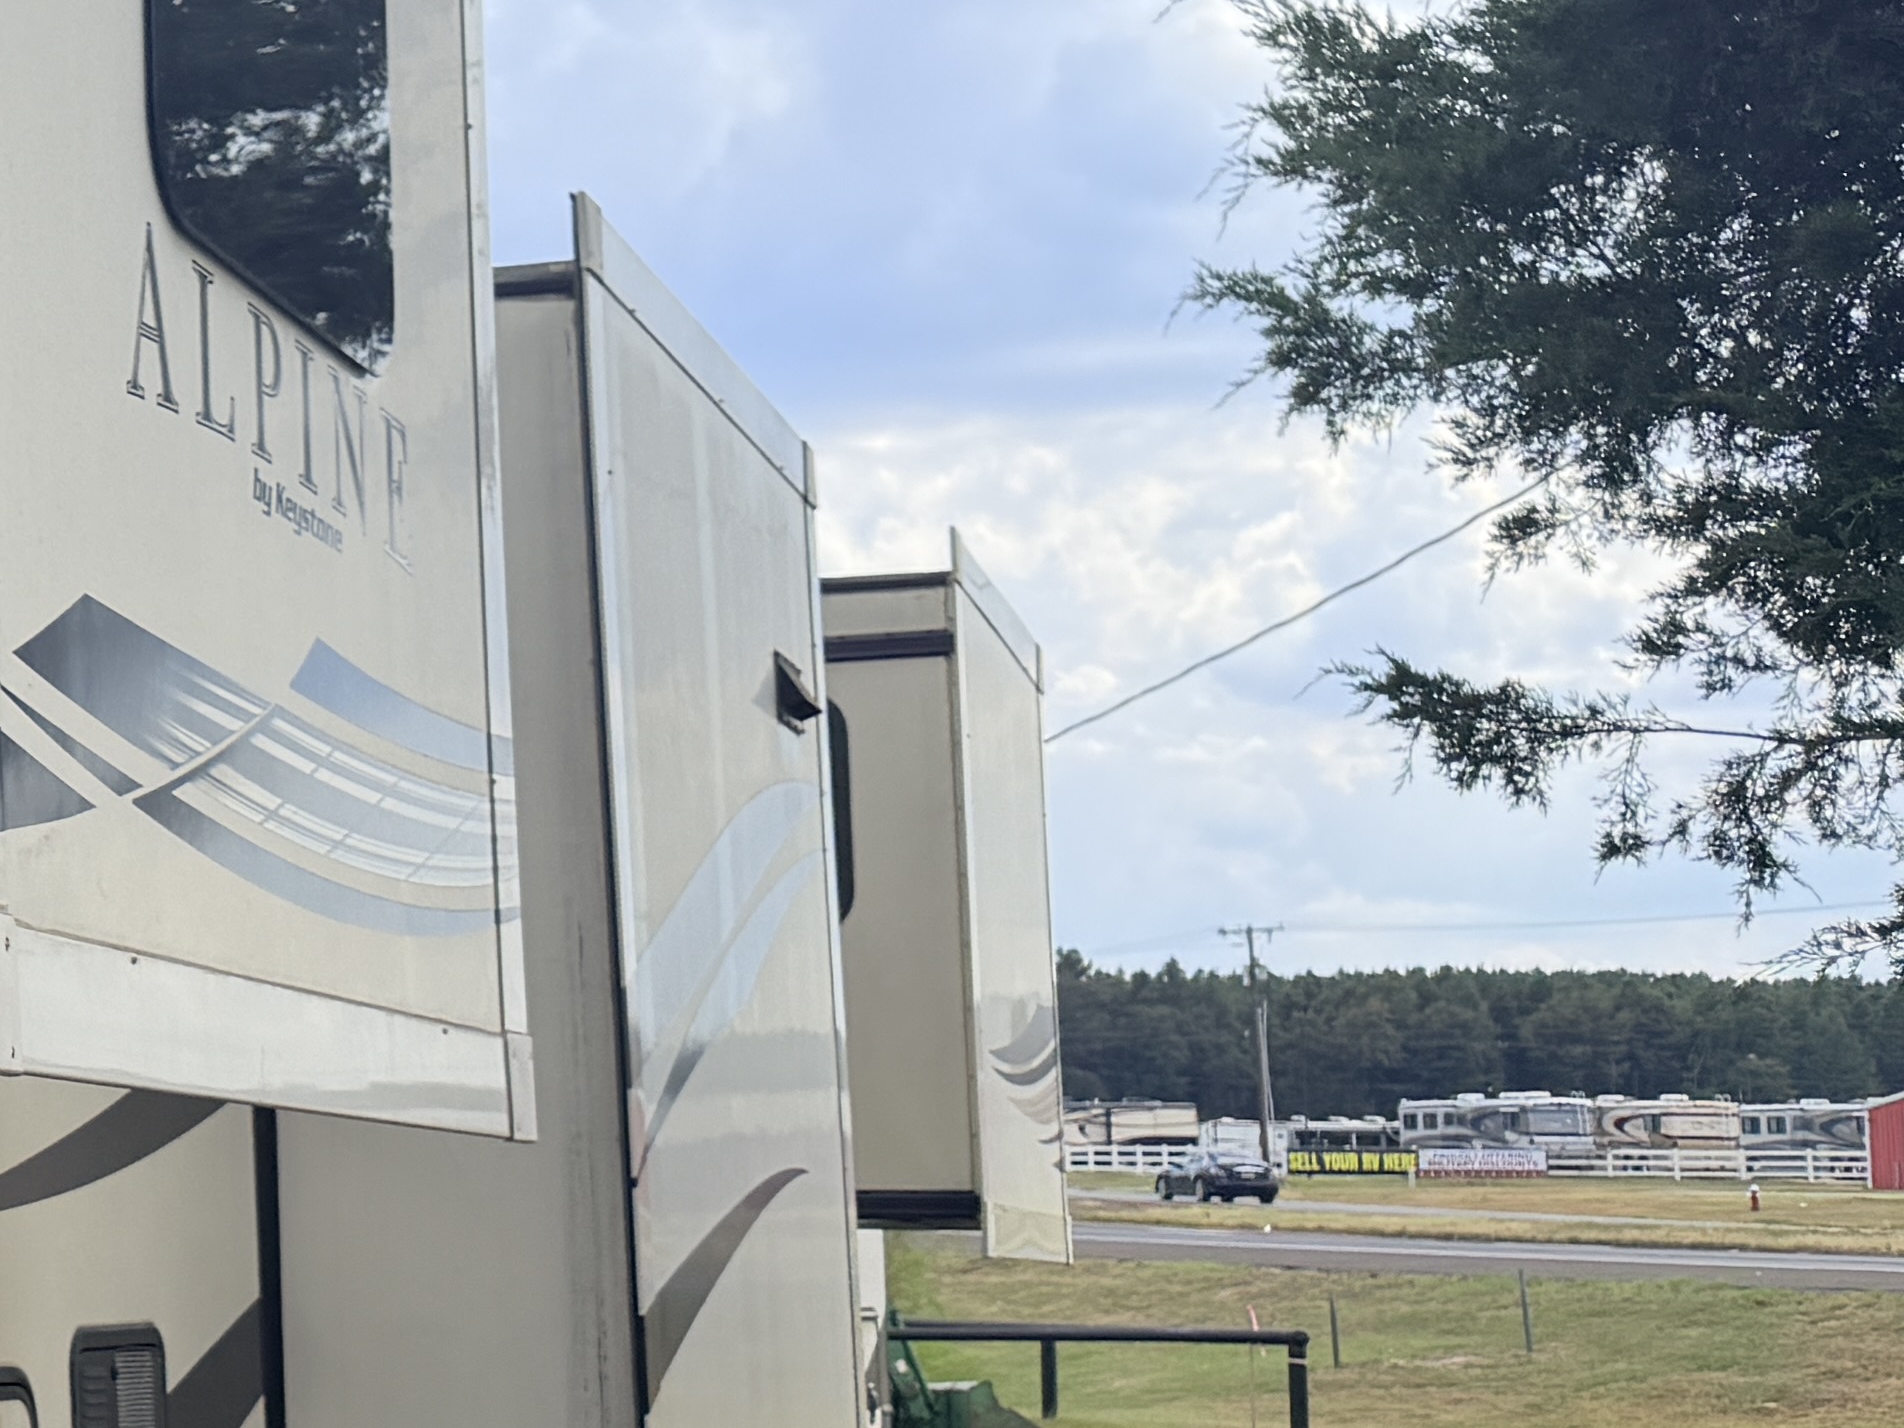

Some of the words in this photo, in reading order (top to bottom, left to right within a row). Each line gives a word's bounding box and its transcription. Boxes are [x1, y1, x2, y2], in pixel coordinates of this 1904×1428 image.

[126, 221, 413, 575] ALPINE
[253, 467, 272, 517] by
[275, 481, 342, 553] Keystone
[1289, 1151, 1320, 1171] SELL
[1323, 1152, 1358, 1171] YOUR
[1362, 1152, 1380, 1171] RV
[1382, 1152, 1417, 1171] HERE
